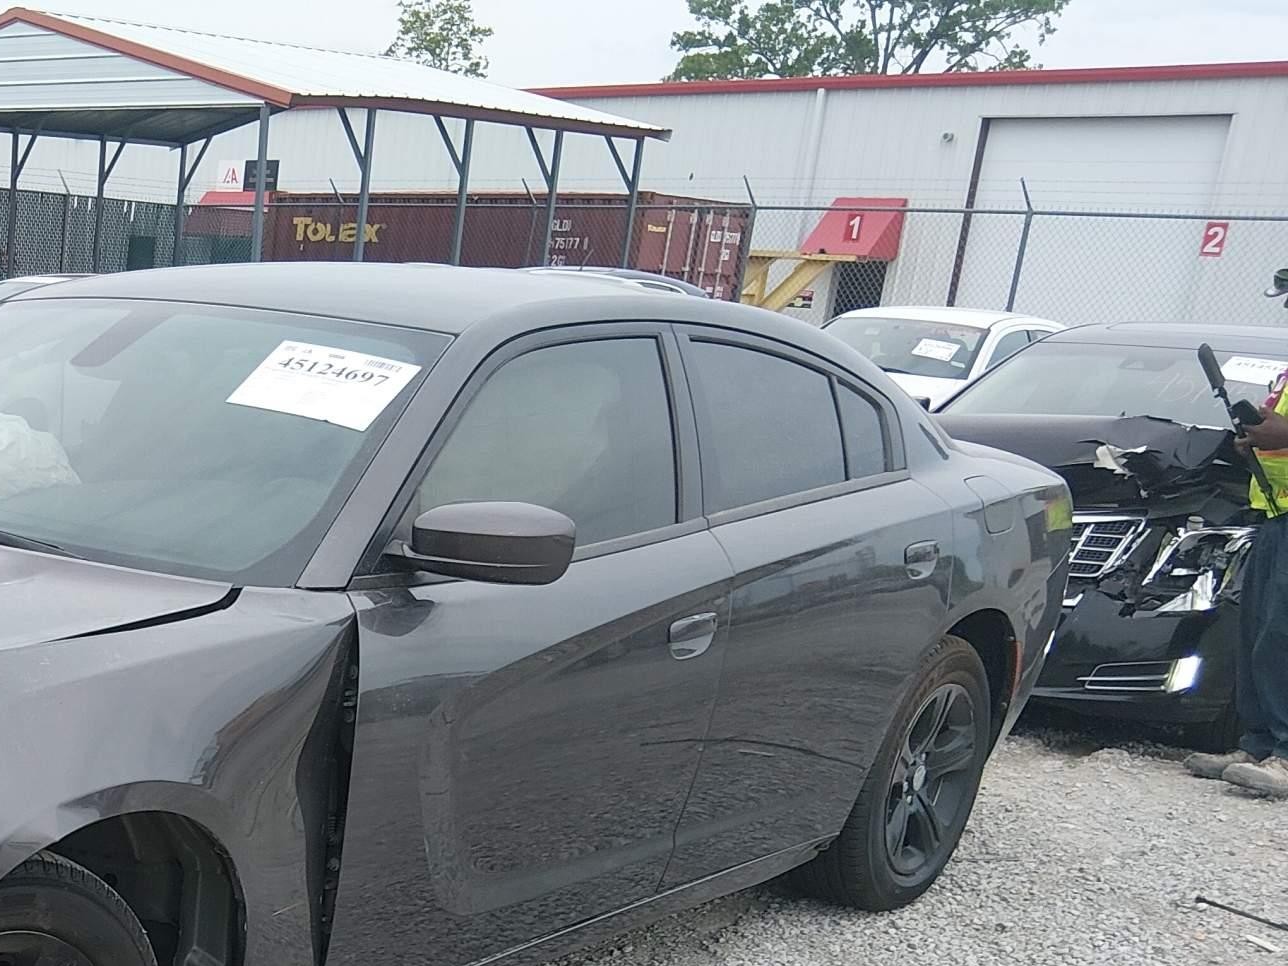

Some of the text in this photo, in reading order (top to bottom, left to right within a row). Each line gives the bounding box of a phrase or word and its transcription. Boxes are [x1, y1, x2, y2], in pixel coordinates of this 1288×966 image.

[849, 215, 861, 239] 1
[1202, 226, 1224, 253] 2
[278, 357, 390, 386] 45124697
